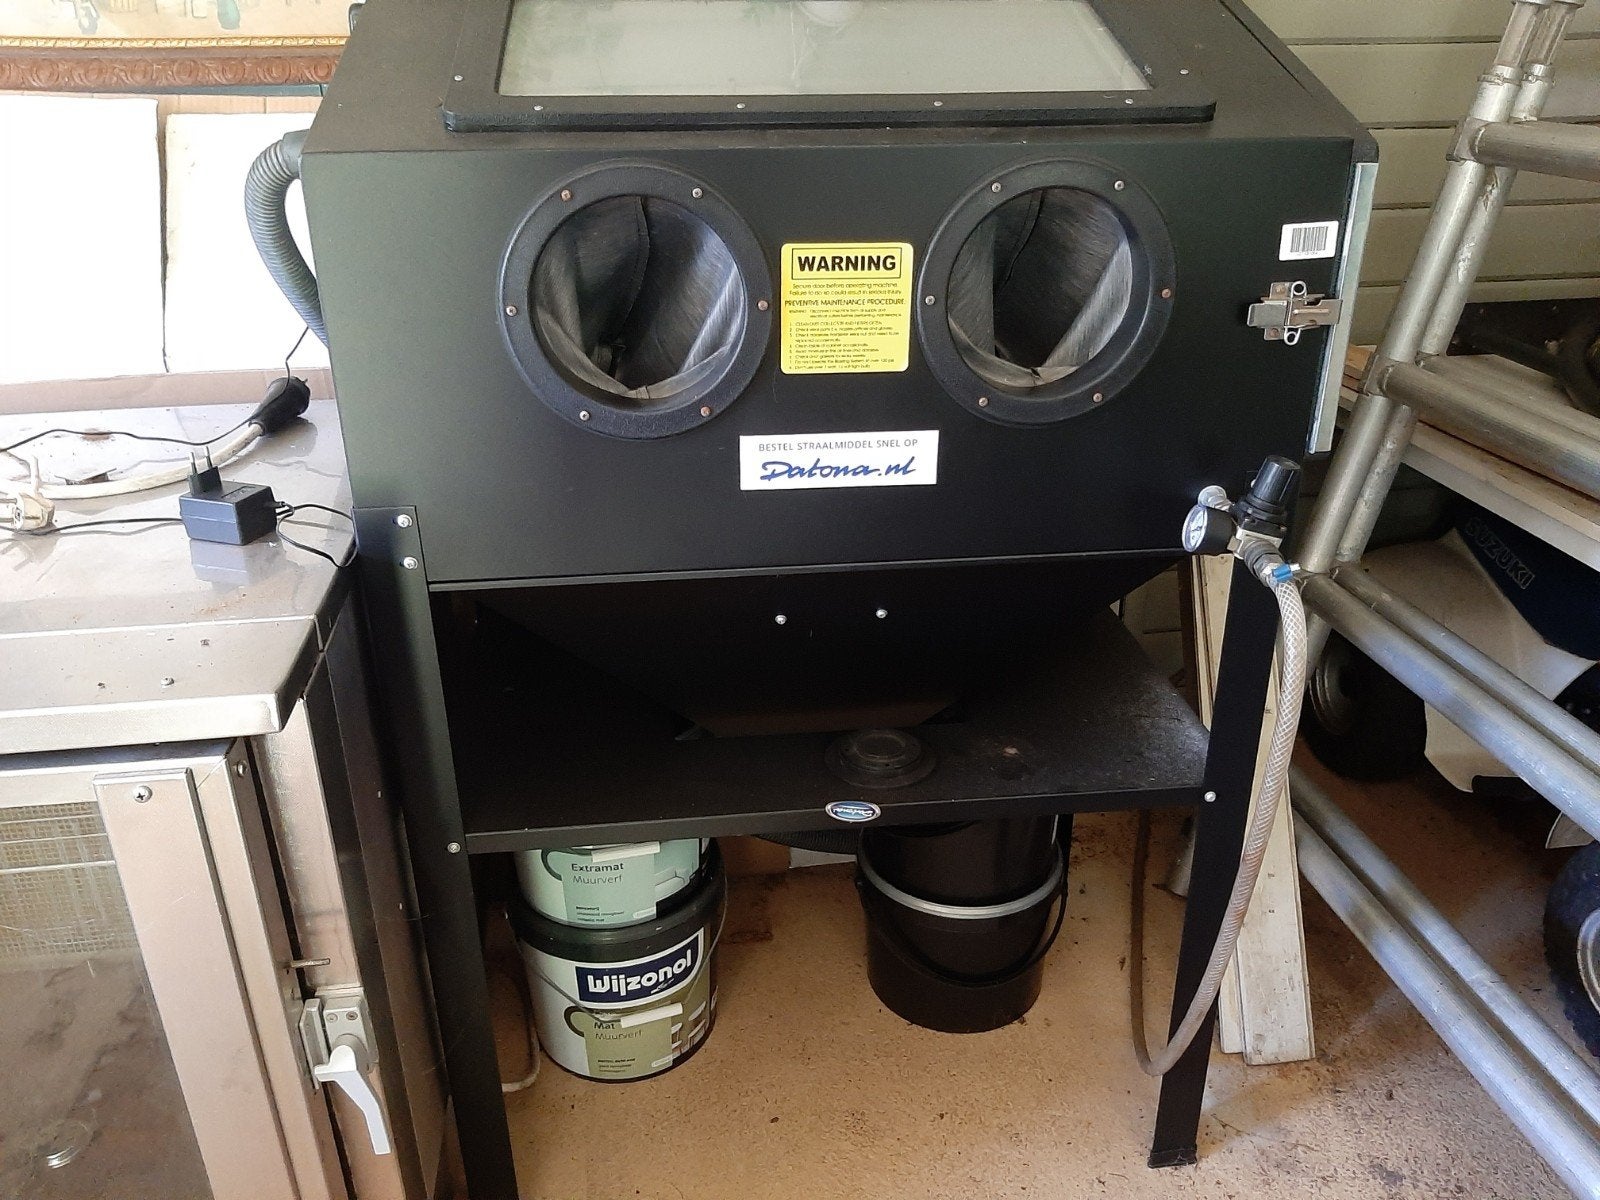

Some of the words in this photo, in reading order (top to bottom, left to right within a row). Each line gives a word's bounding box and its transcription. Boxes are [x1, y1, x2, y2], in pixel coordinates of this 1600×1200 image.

[797, 255, 896, 271] WARNING
[784, 299, 819, 307] PREVENTIVE
[758, 442, 795, 452] BESTEL
[797, 440, 873, 451] STRAALMIDDEL
[876, 439, 900, 448] SNEL
[903, 438, 918, 447] OP
[760, 456, 917, 482] Datona.nl
[1465, 517, 1536, 590] SUZUKI
[571, 863, 624, 872] Extramat
[572, 875, 622, 885] Muurverf
[587, 948, 693, 996] Wijzonol
[593, 1022, 616, 1030] Mat
